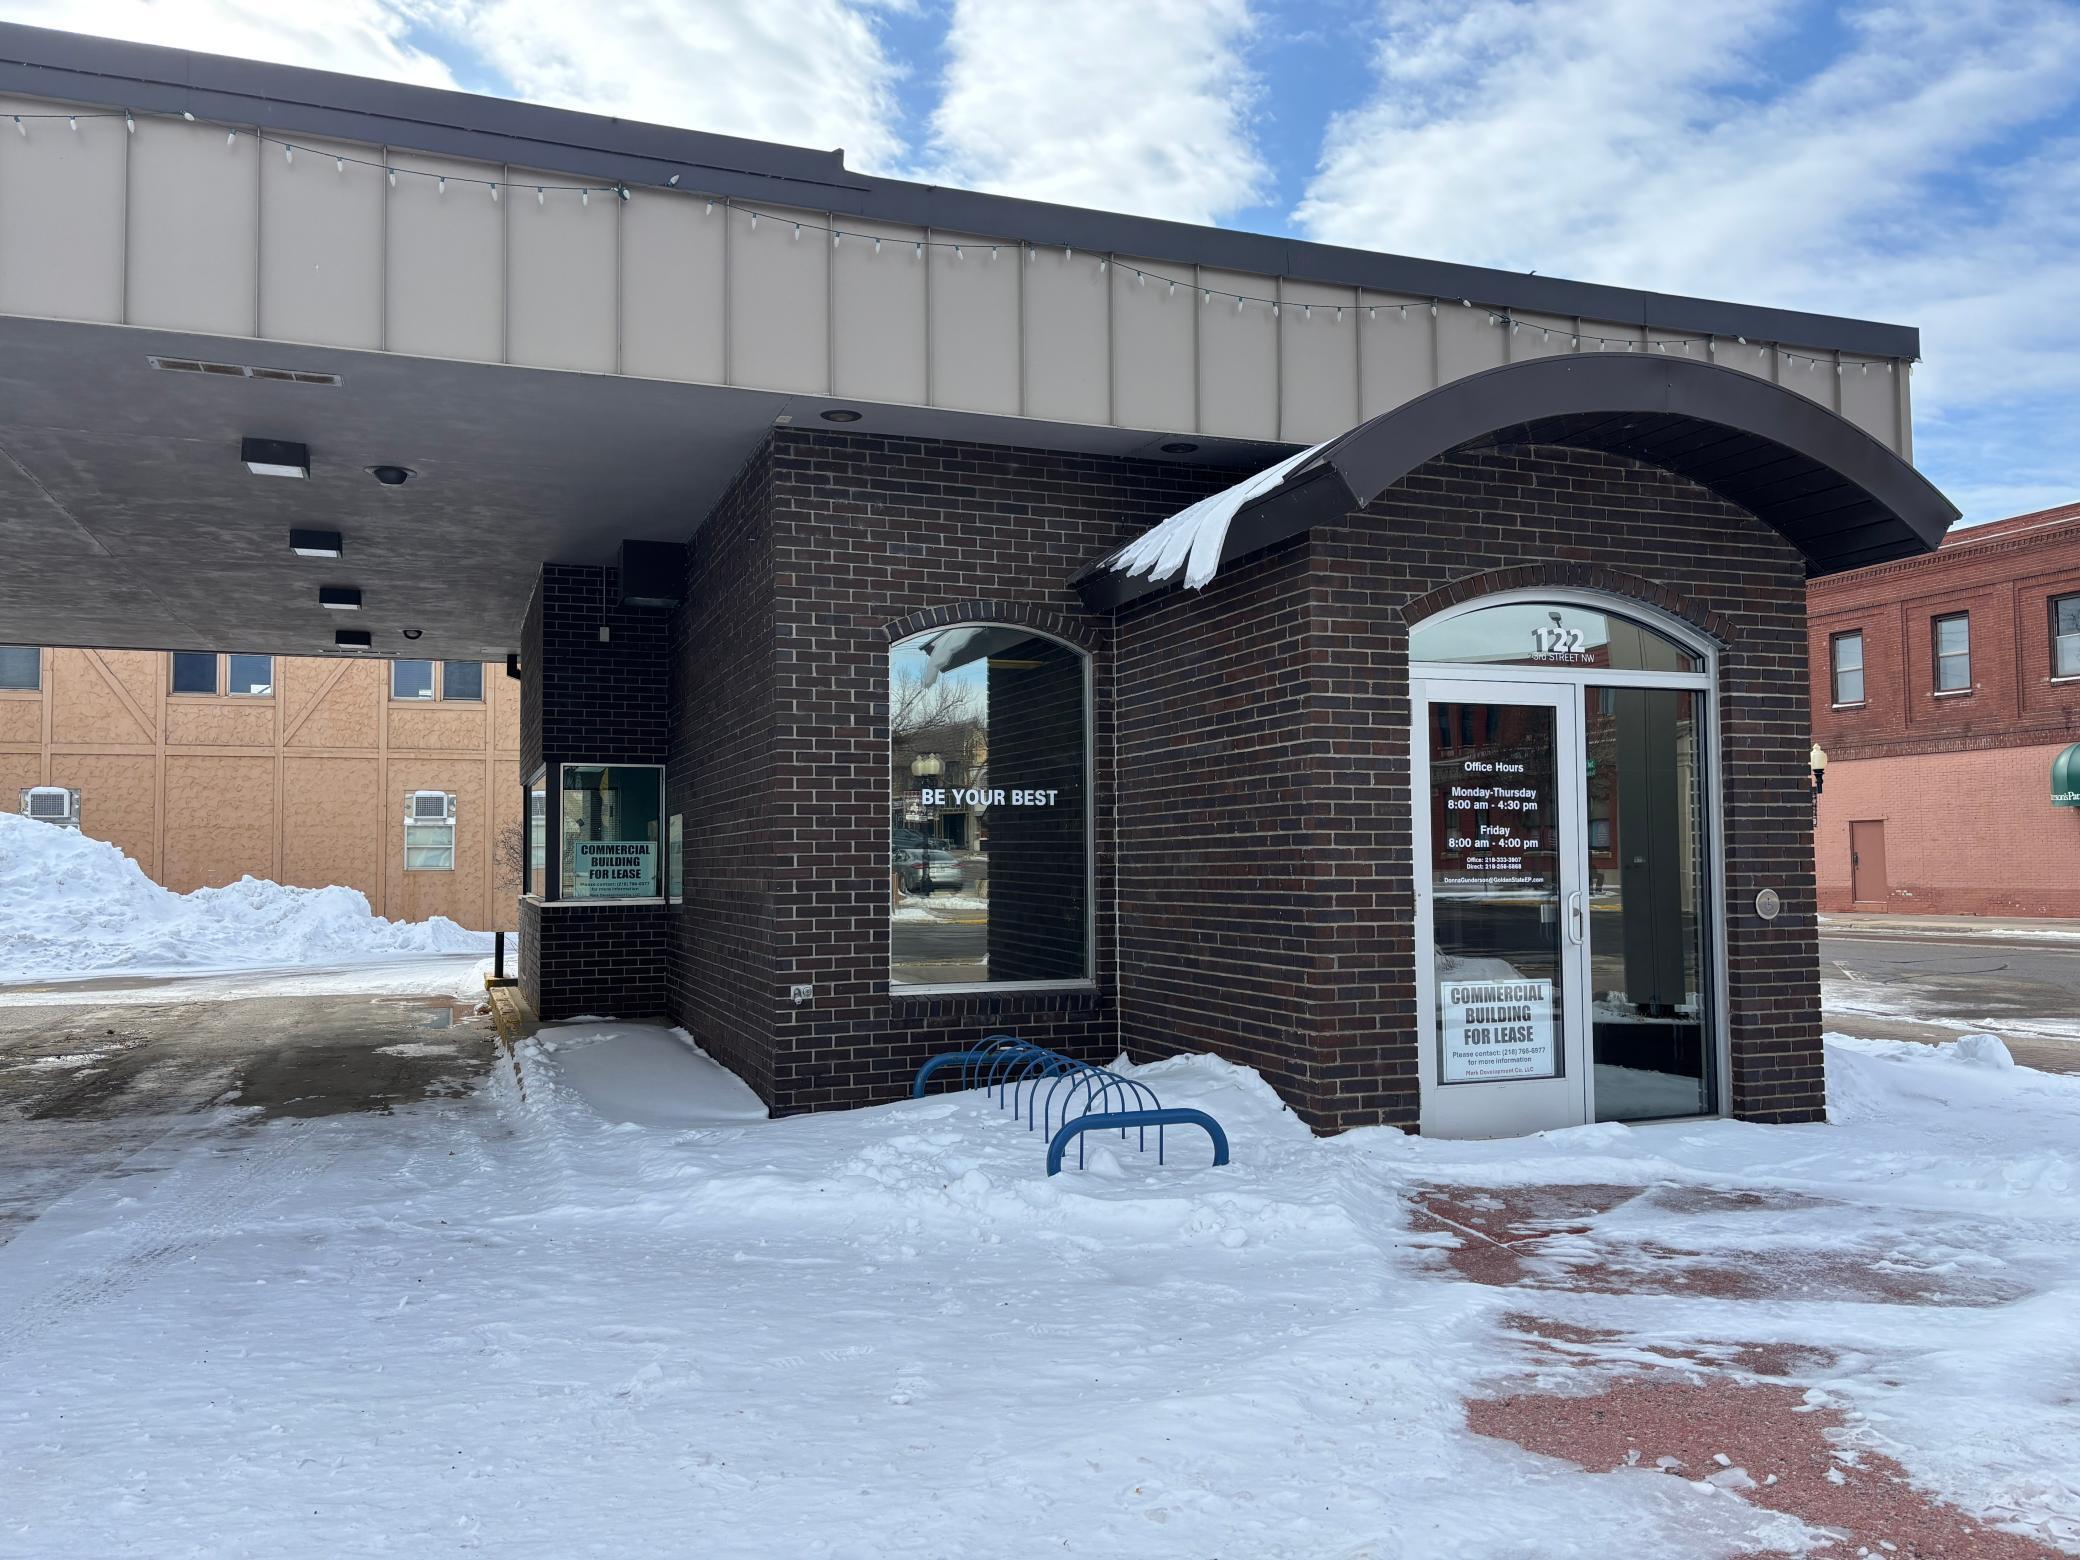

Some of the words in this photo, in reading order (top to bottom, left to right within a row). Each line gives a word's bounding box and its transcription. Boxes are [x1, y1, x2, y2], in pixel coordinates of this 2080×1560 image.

[1536, 626, 1586, 653] 122
[1548, 652, 1580, 663] STREET
[1581, 653, 1595, 664] NW
[1464, 761, 1493, 772] Office
[1495, 762, 1524, 773] Hours
[921, 788, 946, 805] BE
[951, 788, 1006, 806] YOUR
[1011, 789, 1058, 806] BEST
[1451, 786, 1537, 800] Monday-Thursday
[1447, 799, 1471, 810] 8:00
[1473, 801, 1489, 810] am
[1497, 800, 1520, 810] 4:30
[1522, 801, 1538, 812] pm
[1480, 825, 1511, 837] Friday
[1448, 837, 1472, 848] 8:00
[1474, 839, 1490, 848] am
[1498, 838, 1521, 848] 4:00
[1523, 839, 1539, 850] pm
[580, 844, 651, 856] COMMERCIAL
[591, 856, 640, 867] BUILDING
[589, 868, 609, 880] FOR
[611, 868, 642, 880] LEASE
[1450, 984, 1544, 1005] COMMERCIAL
[1465, 1005, 1531, 1024] BUILDING
[1464, 1027, 1491, 1046] FOR
[1494, 1025, 1534, 1044] LEASE
[1452, 1051, 1474, 1059] Please
[1502, 1048, 1518, 1057] (218)
[1495, 1056, 1532, 1064] information
